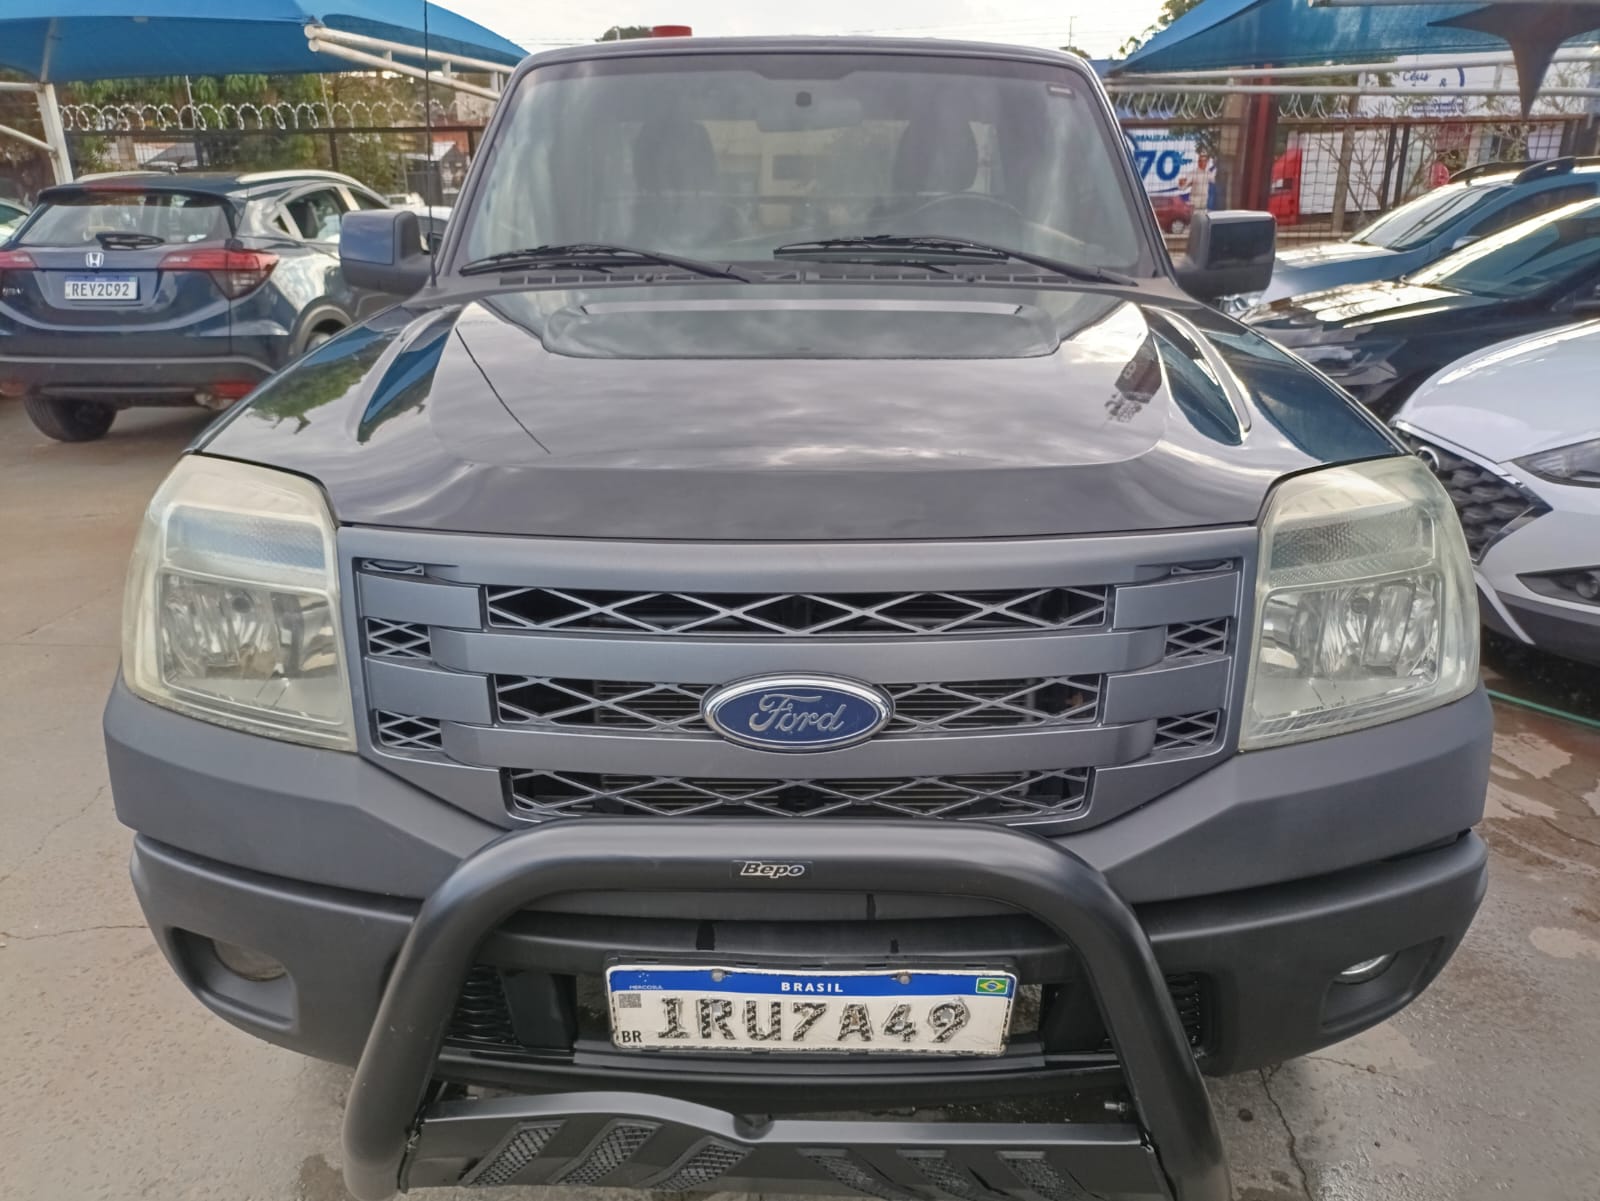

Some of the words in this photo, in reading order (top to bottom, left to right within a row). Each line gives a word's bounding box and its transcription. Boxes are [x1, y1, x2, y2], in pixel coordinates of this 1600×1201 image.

[71, 283, 130, 297] REY2C92
[748, 692, 848, 732] Ford
[740, 860, 806, 879] Bepo
[780, 981, 844, 994] BRASIL
[621, 1030, 643, 1043] BR
